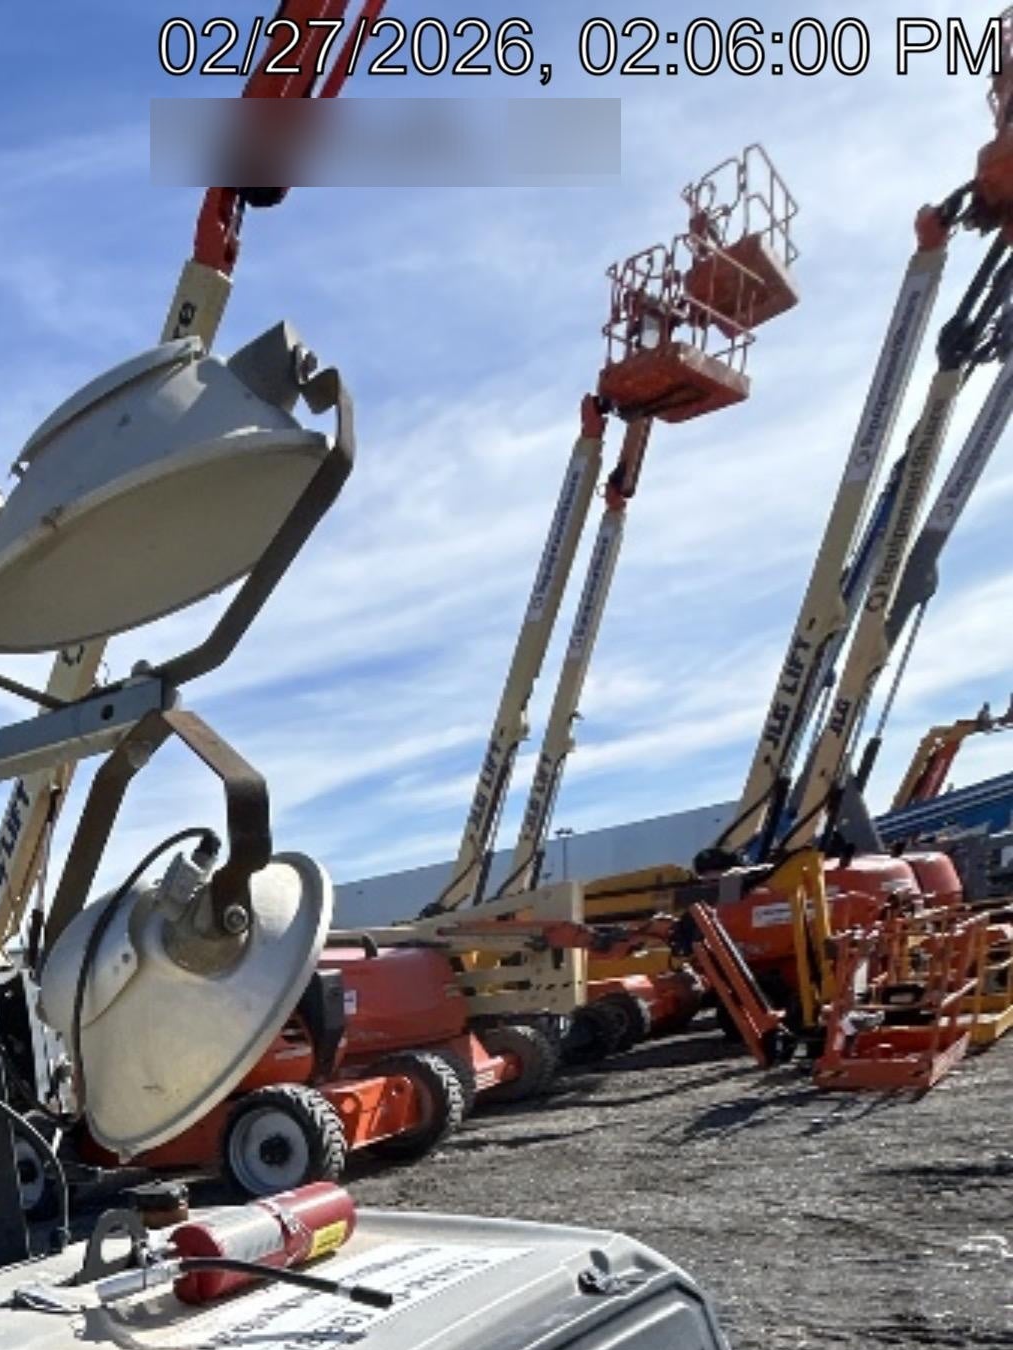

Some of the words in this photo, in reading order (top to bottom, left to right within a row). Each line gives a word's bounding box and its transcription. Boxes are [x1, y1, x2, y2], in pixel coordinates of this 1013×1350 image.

[764, 702, 790, 748] JLG
[779, 635, 811, 696] LIFT
[830, 698, 851, 737] JLG
